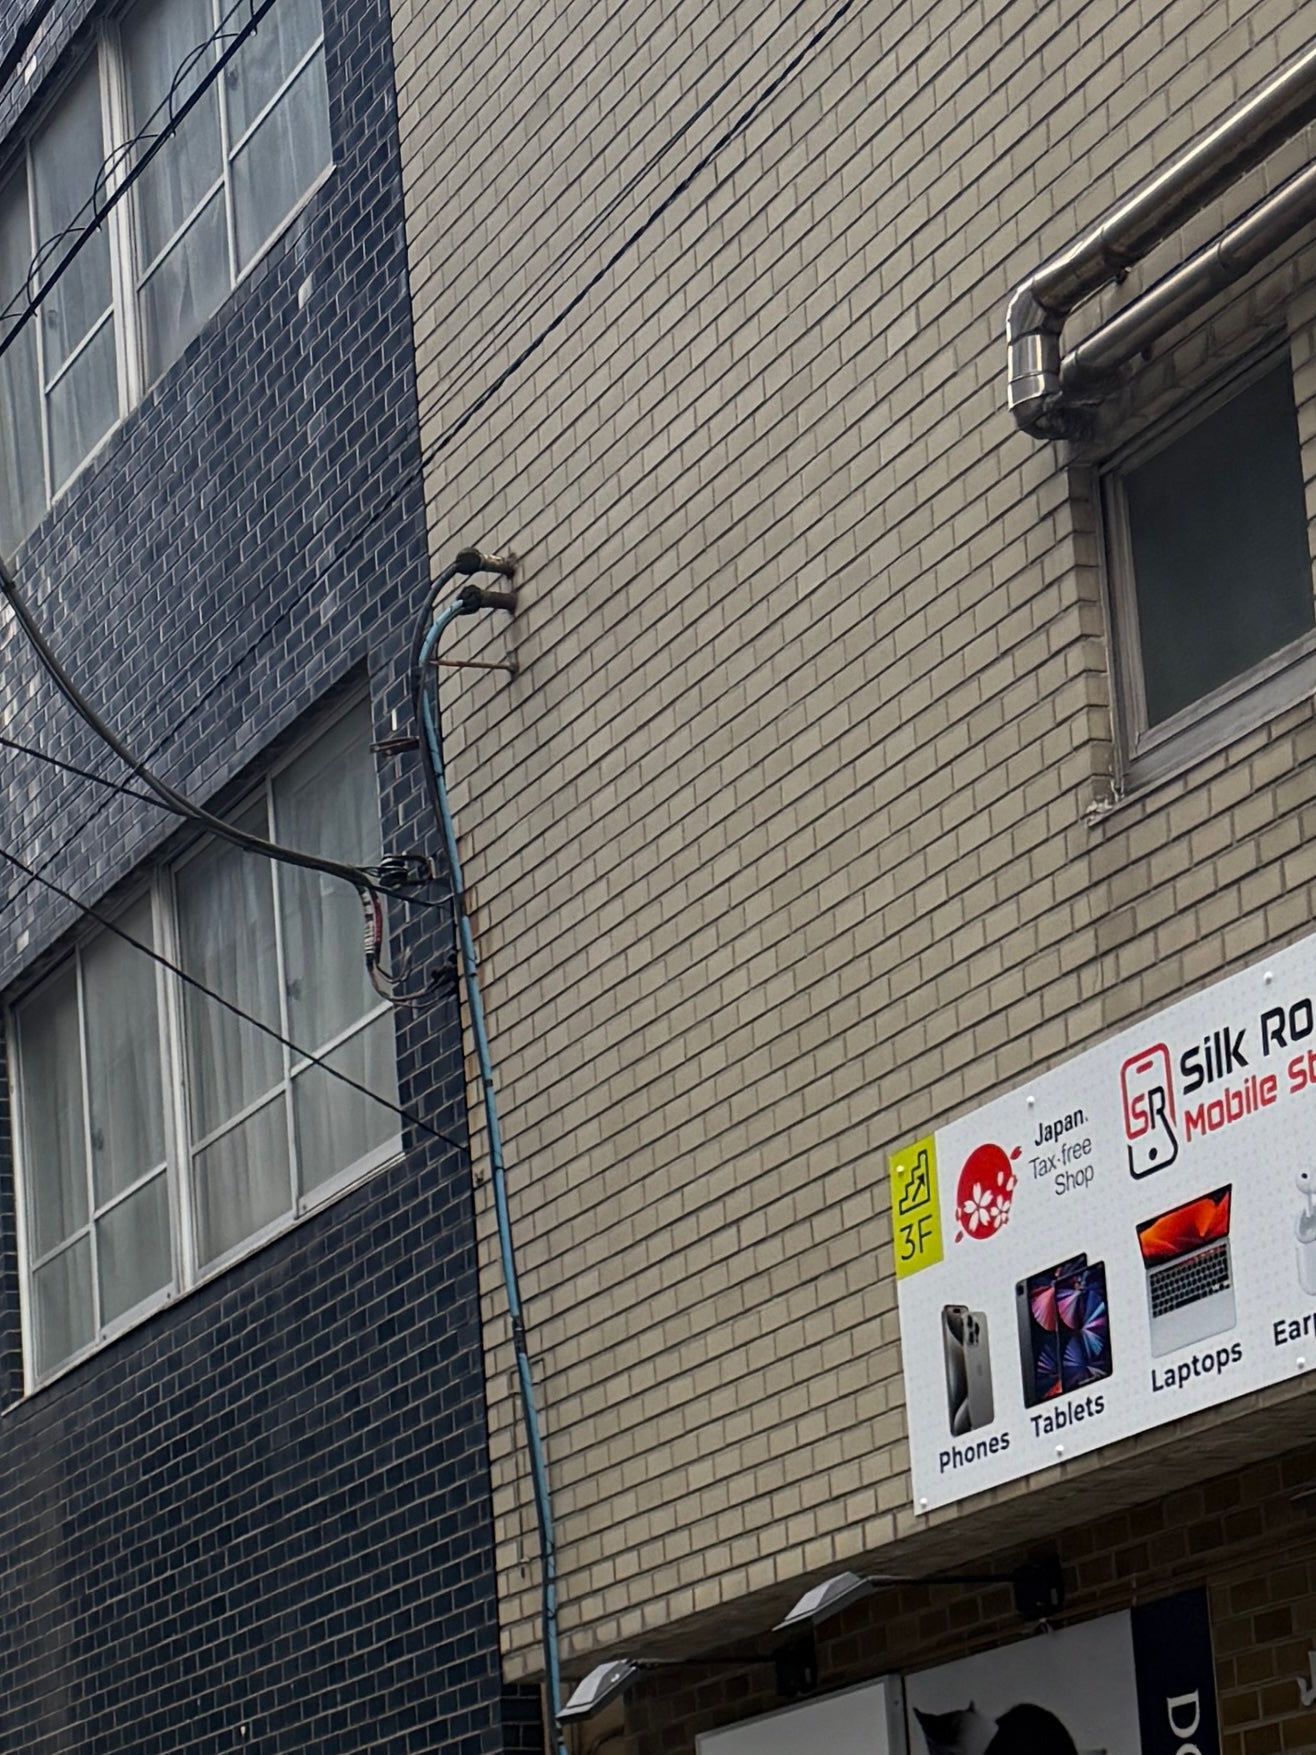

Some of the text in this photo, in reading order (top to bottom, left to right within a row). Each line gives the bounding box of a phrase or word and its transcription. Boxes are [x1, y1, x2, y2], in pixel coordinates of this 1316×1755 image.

[1180, 1027, 1249, 1095] Silk
[1184, 1074, 1277, 1143] Mobile
[1029, 1138, 1093, 1179] Tax-free
[1054, 1165, 1095, 1196] Shop
[899, 1214, 933, 1260] 3F
[1151, 1342, 1243, 1392] Laptops
[1030, 1394, 1106, 1438] Tablets
[939, 1431, 1011, 1474] Phones
